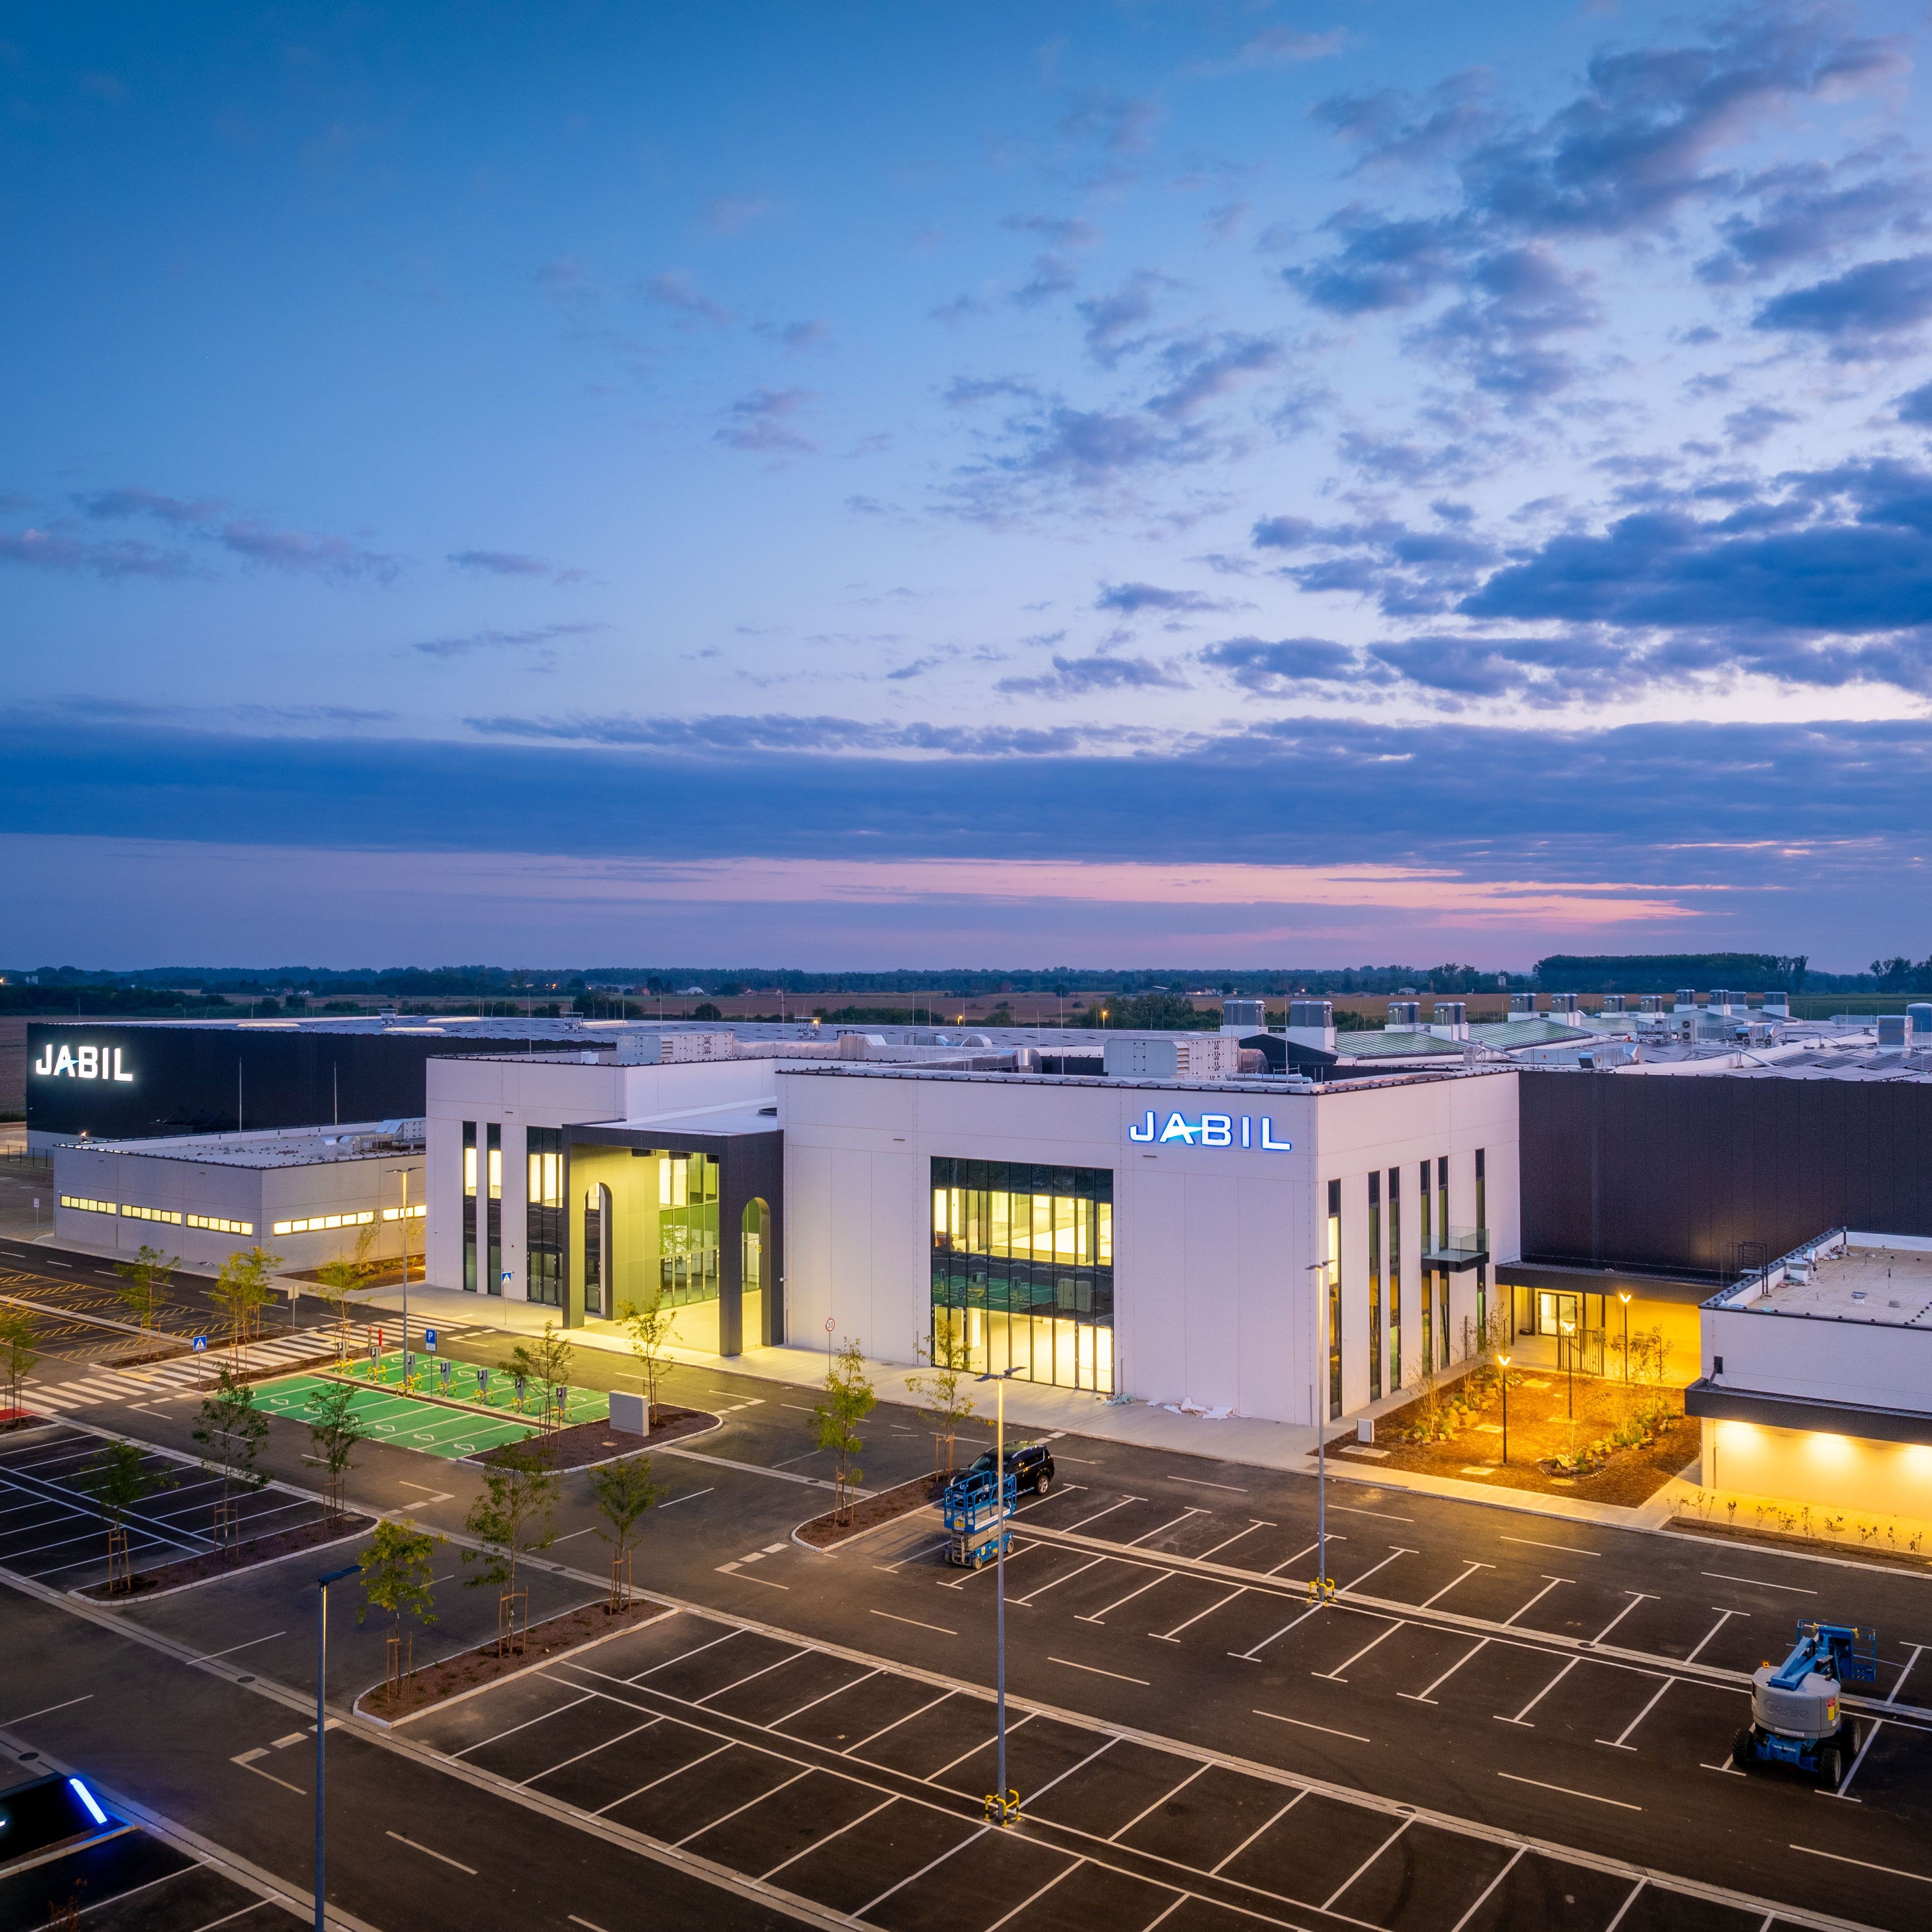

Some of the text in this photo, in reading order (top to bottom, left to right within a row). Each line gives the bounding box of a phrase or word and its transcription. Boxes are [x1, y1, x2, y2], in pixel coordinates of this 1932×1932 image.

[35, 1044, 133, 1082] JABIL
[1129, 1111, 1292, 1151] JABIL
[428, 1331, 433, 1340] P
[1764, 1699, 1810, 1720] Genie
